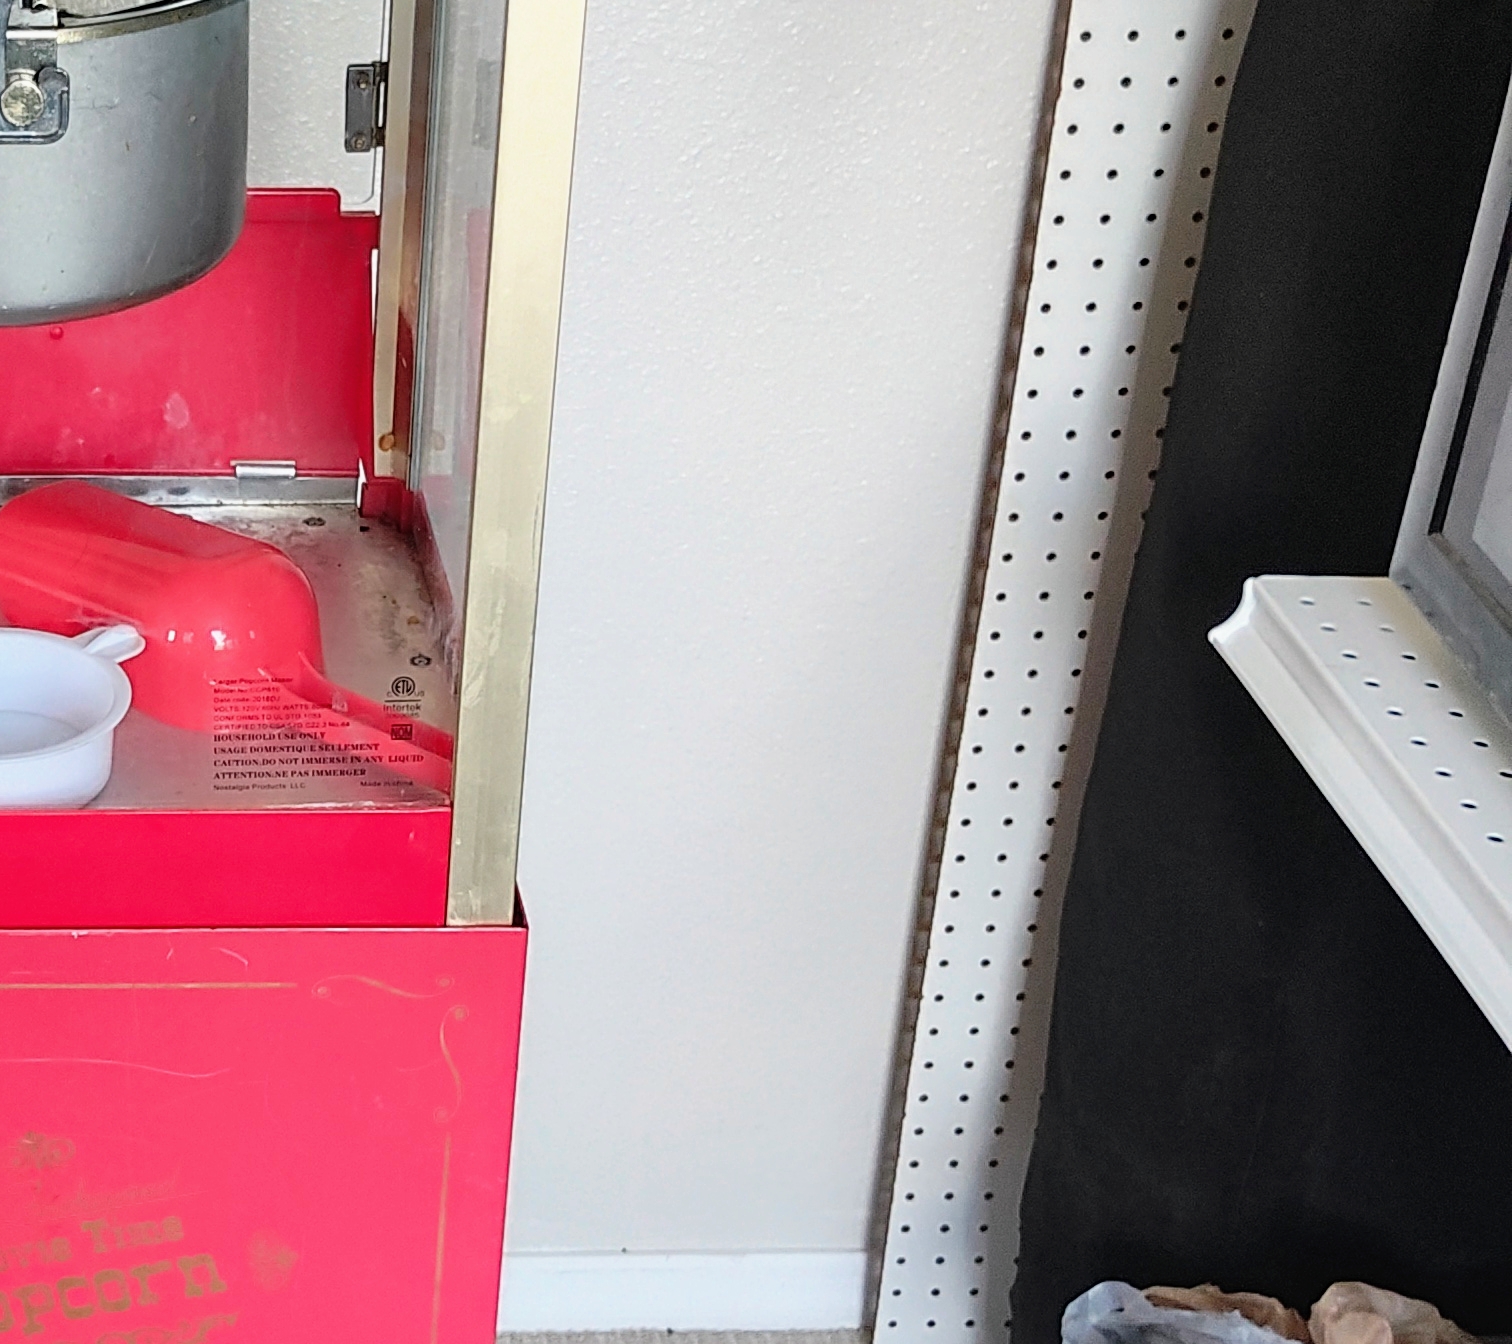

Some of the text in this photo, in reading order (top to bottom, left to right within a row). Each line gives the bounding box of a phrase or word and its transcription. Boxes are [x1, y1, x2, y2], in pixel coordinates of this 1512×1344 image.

[383, 702, 423, 712] Intertek
[262, 713, 272, 721] TO
[213, 722, 256, 731] CERTIFIED
[258, 722, 268, 730] TO
[213, 731, 326, 742] HOUSEHOLD USE ONLY
[213, 743, 380, 755] USAGE DOMESTIQUE SEULEMENT
[278, 757, 299, 765] NOT
[301, 756, 348, 765] IMMERSE
[350, 755, 361, 763] IN
[362, 755, 384, 763] ANY
[388, 754, 424, 763] LIQUID
[290, 770, 309, 778] PAS
[311, 768, 367, 777] IMMERGER
[213, 783, 250, 791] Nostalgia
[81, 1212, 186, 1256] Time
